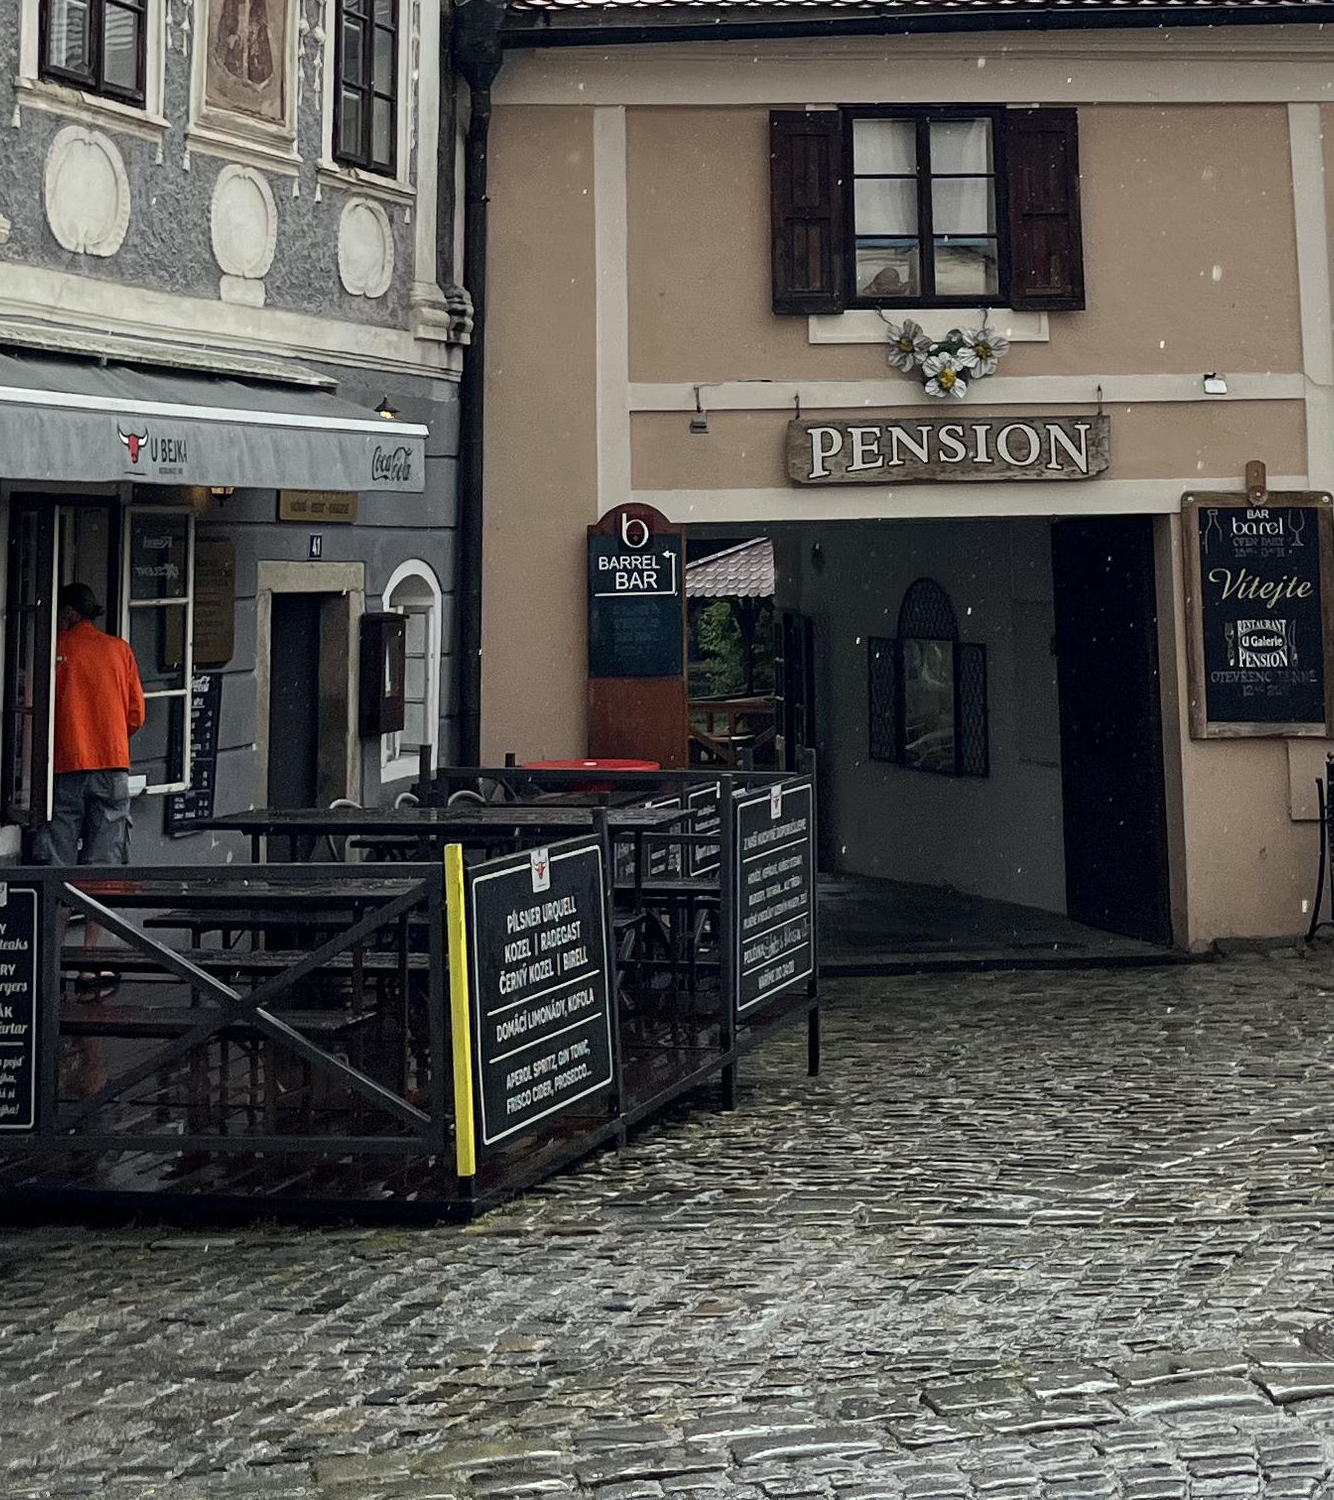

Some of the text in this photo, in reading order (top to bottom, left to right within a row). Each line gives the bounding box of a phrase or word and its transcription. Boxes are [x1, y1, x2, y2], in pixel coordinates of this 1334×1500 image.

[150, 437, 158, 462] U
[806, 423, 1091, 479] PENSION
[1246, 509, 1270, 520] BAR
[597, 555, 661, 571] BARREL
[615, 571, 658, 590] BAR
[1208, 568, 1314, 609] Vítejte
[1236, 619, 1287, 636] RESTAURANT
[1250, 636, 1283, 648] Galerie
[1238, 648, 1288, 668] PENSION
[542, 895, 577, 923] URQUELL
[504, 920, 581, 964] KOZEL RADEGAST
[498, 962, 528, 995] ČERNÝ
[528, 958, 555, 984] KOZEL
[496, 1009, 527, 1043] DOMÁCÍ
[567, 987, 595, 1013] KOFOLA
[506, 1065, 533, 1091] APEROL
